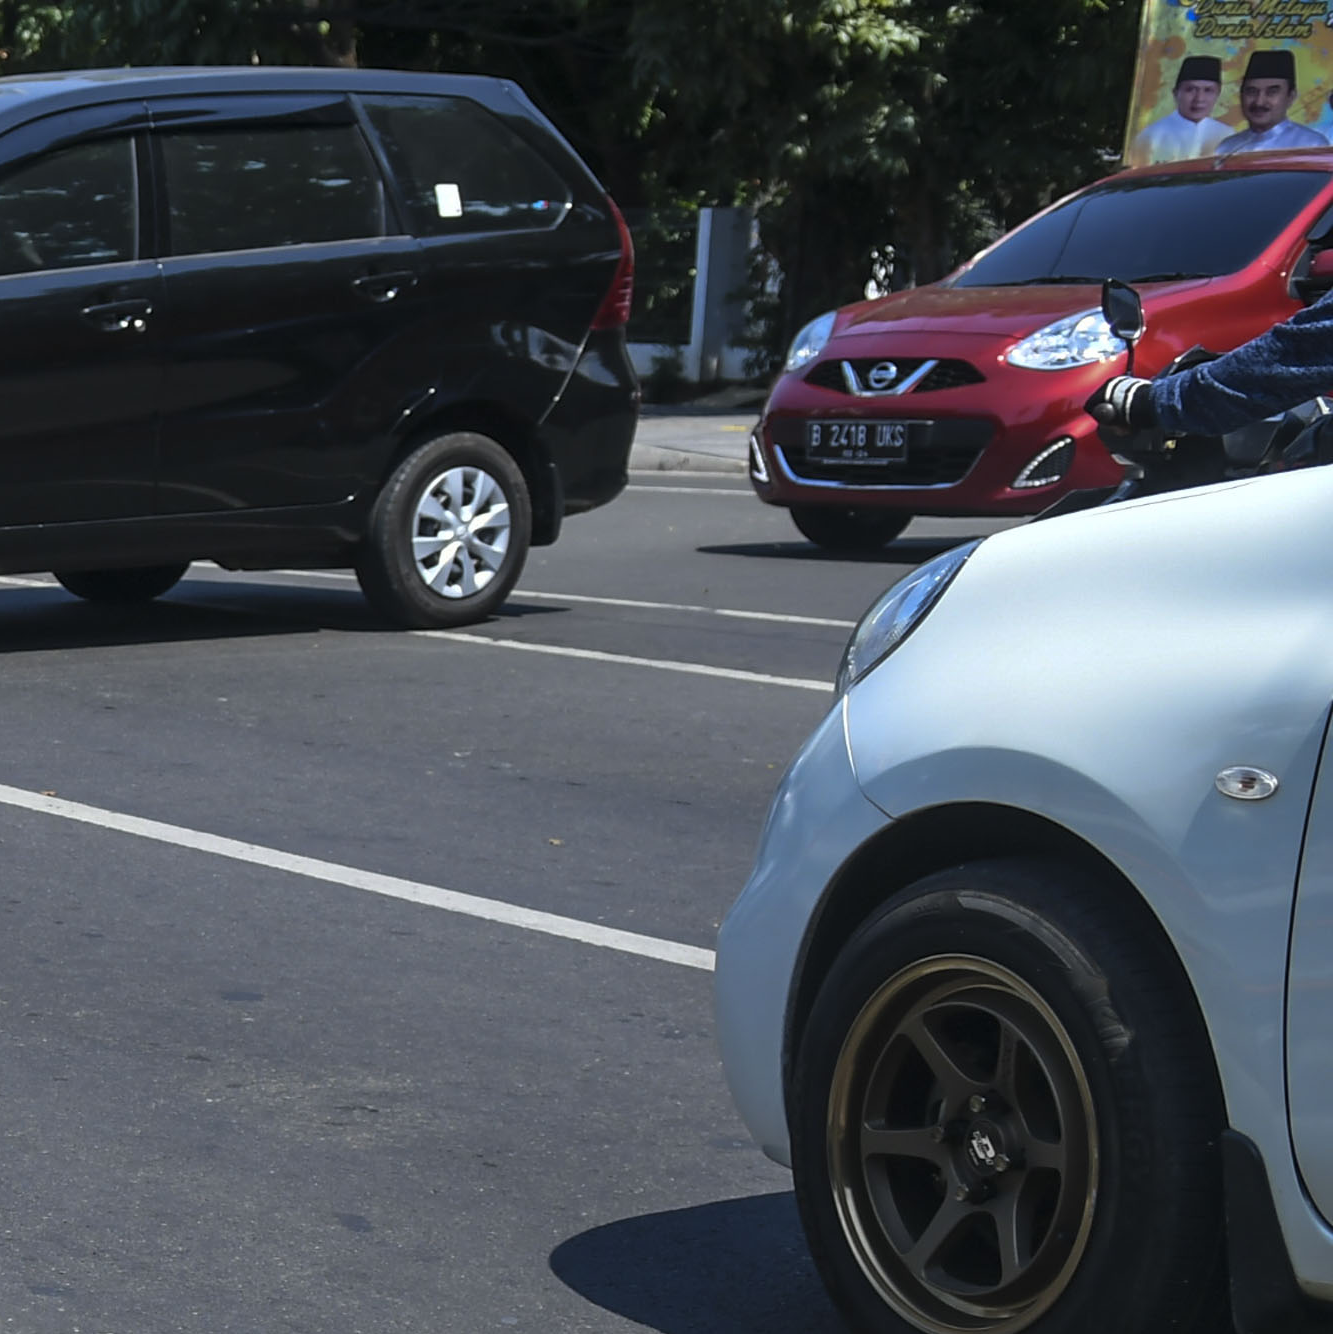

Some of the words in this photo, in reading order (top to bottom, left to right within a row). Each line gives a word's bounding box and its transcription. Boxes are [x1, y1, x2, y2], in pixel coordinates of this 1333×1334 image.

[1196, 17, 1252, 37] Dunia
[1254, 17, 1311, 37] Islam
[811, 424, 821, 446] B
[830, 424, 867, 446] 2418
[876, 424, 904, 446] UKS
